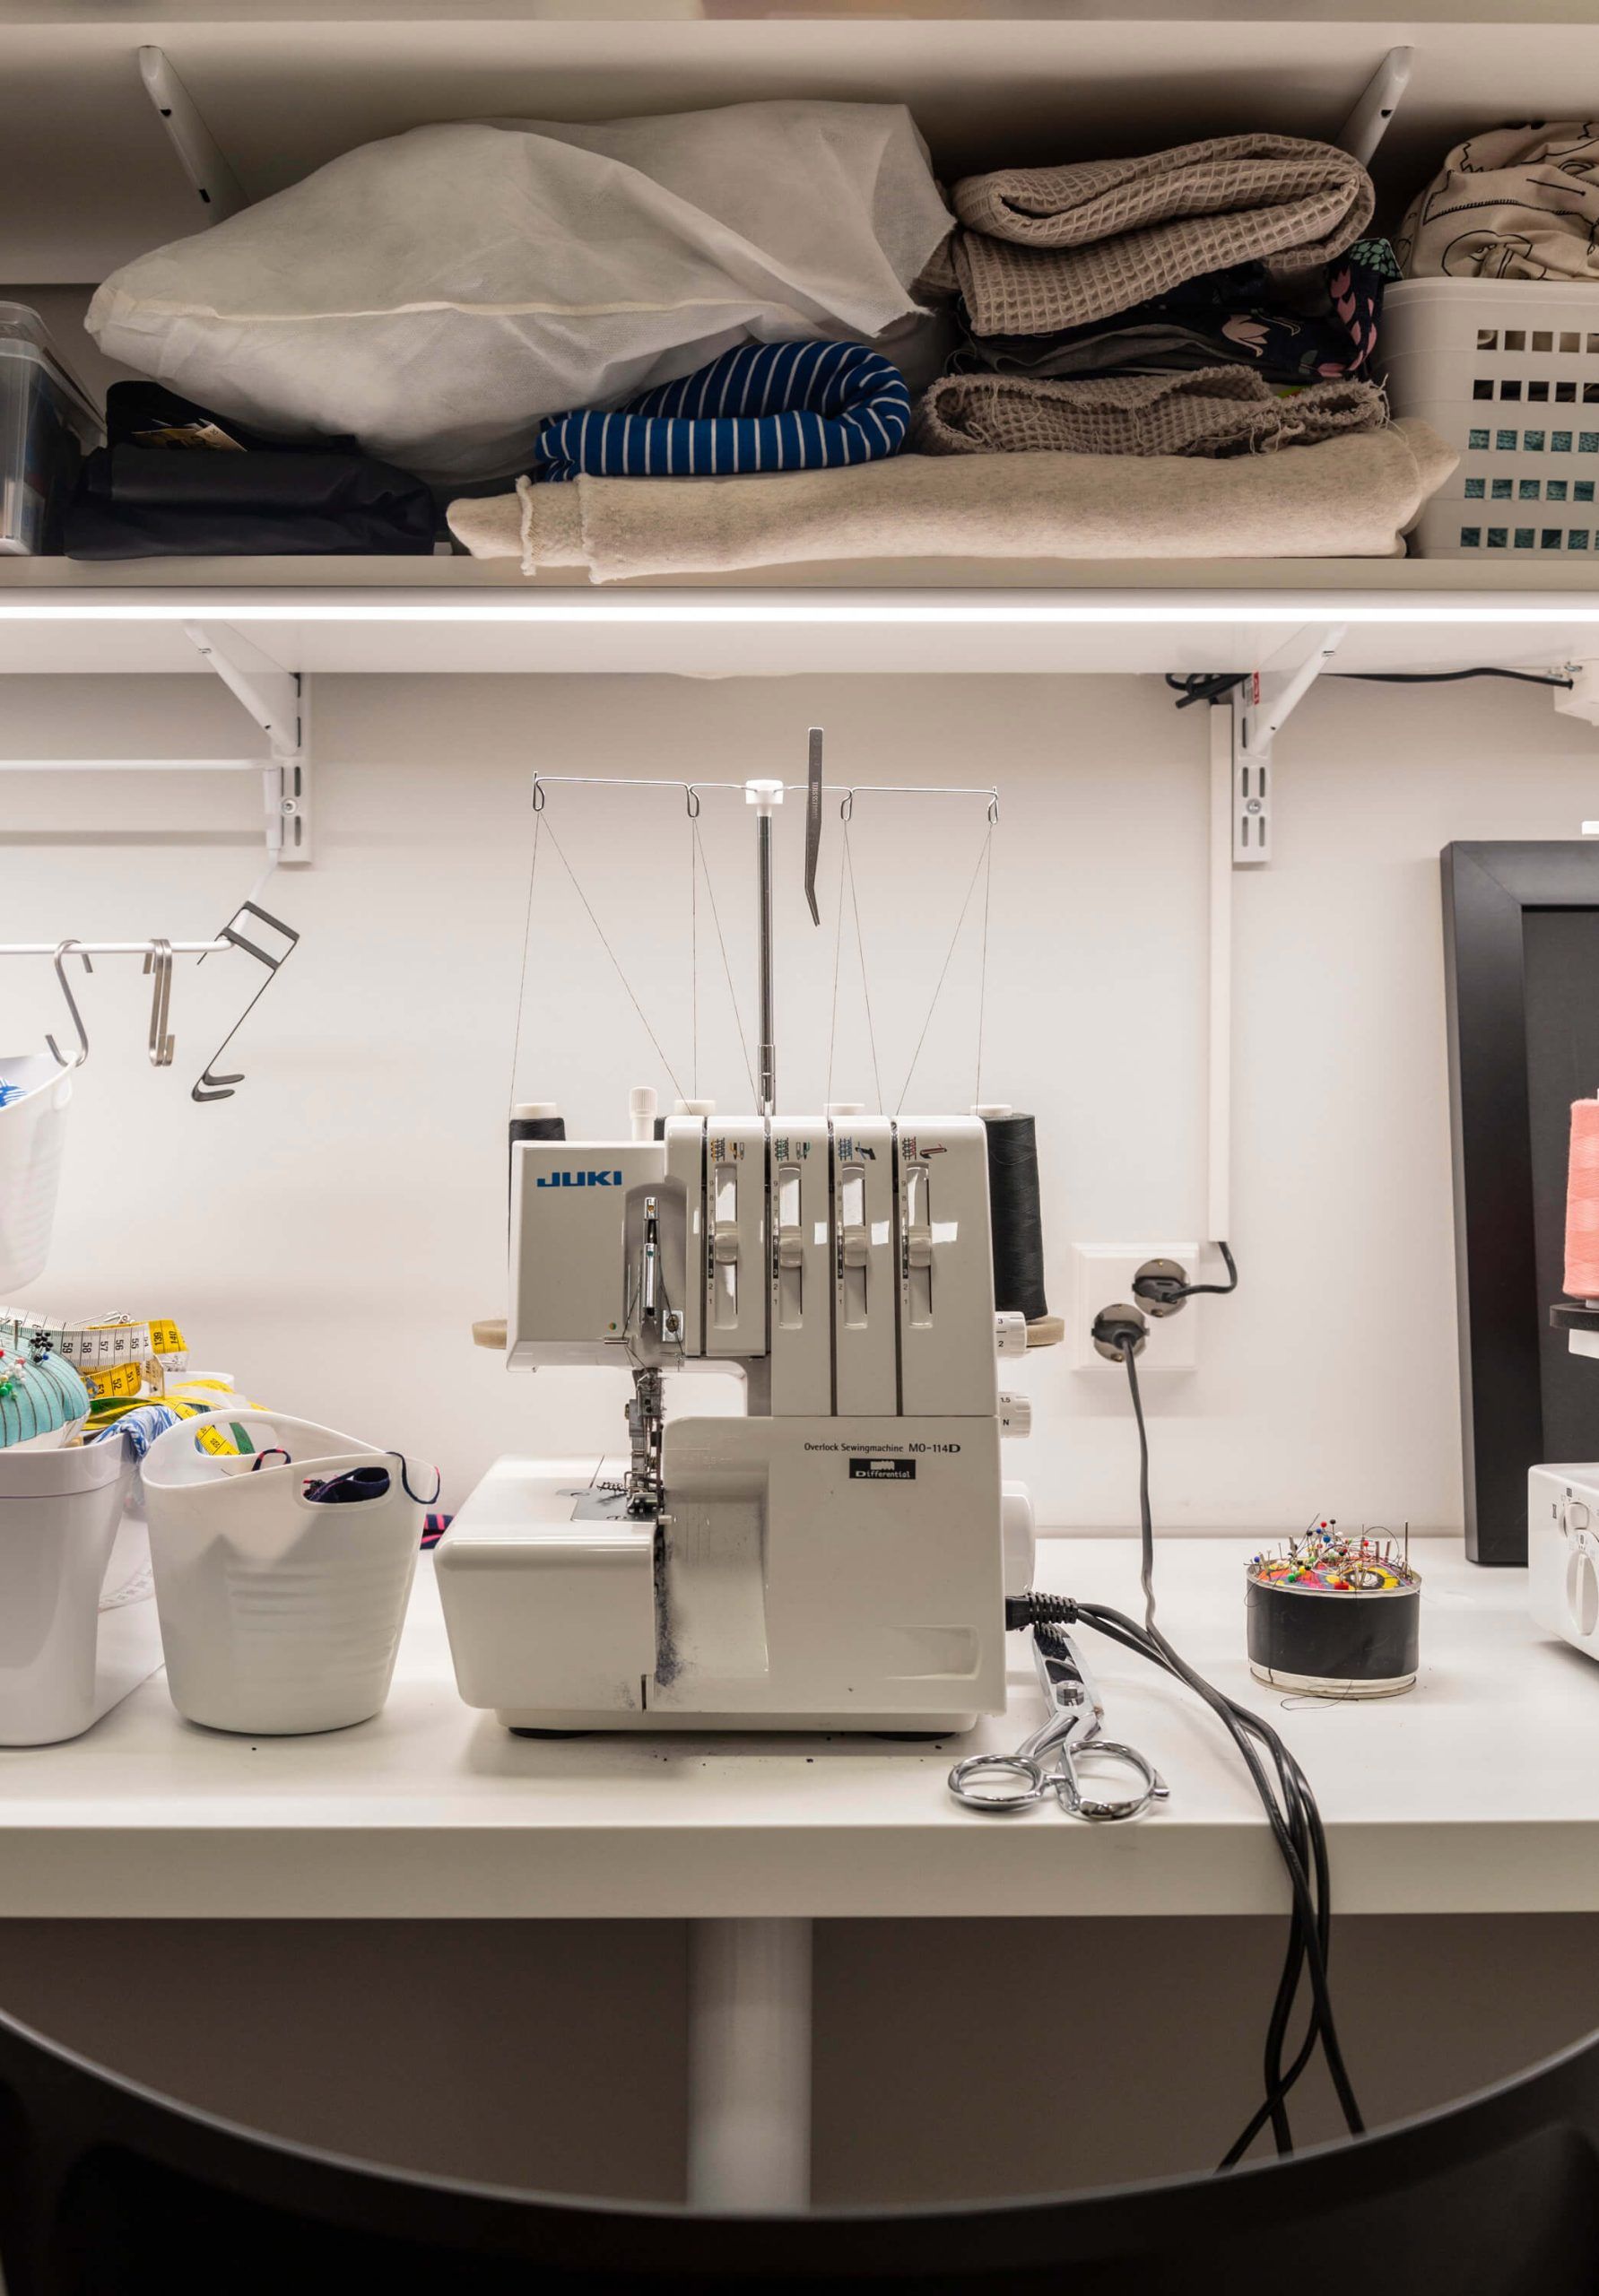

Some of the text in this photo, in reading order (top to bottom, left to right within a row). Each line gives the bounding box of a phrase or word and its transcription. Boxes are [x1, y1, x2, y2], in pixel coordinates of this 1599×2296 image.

[537, 1170, 621, 1187] JUKI
[153, 1332, 163, 1345] 139
[169, 1331, 178, 1344] 140
[63, 1343, 73, 1353] 59
[83, 1343, 91, 1352] 58
[100, 1341, 109, 1352] 57
[115, 1339, 124, 1350] 56
[131, 1338, 139, 1349] 55
[126, 1371, 134, 1382] 51
[113, 1378, 122, 1390] 52
[804, 1442, 960, 1454] Overlock Sewingmachine MO-114D
[856, 1470, 910, 1478] Differential
